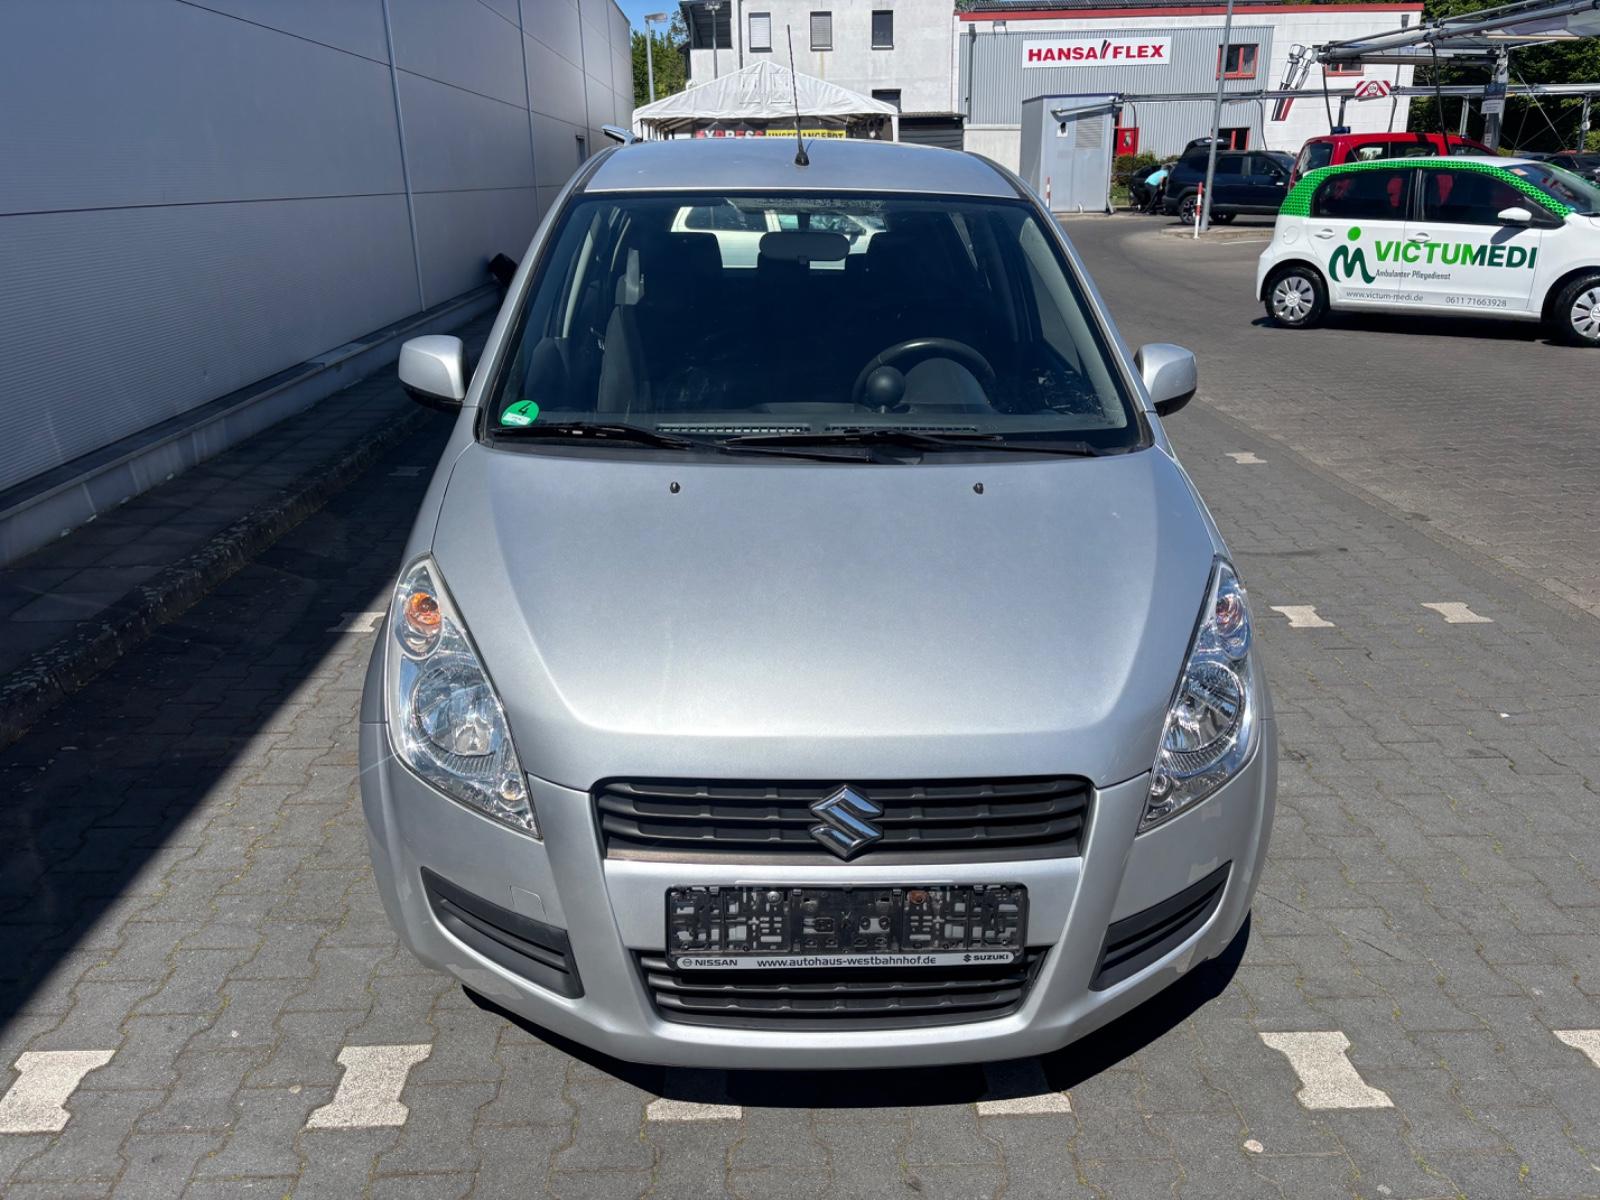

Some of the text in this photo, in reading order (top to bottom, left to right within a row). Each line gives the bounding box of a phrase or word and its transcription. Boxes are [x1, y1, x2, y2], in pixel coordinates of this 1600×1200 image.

[1028, 44, 1164, 62] HANSA FLEX
[1374, 240, 1538, 269] VICTUMEDI
[1375, 269, 1451, 281] Ambulanter Pflegedienst
[1345, 290, 1424, 302] www.victum-medi.de
[1445, 296, 1507, 307] 0611 71663928
[518, 402, 532, 416] 4
[694, 959, 738, 967] NISSAN
[757, 956, 937, 967] www.autohaus-westbahnhof.de
